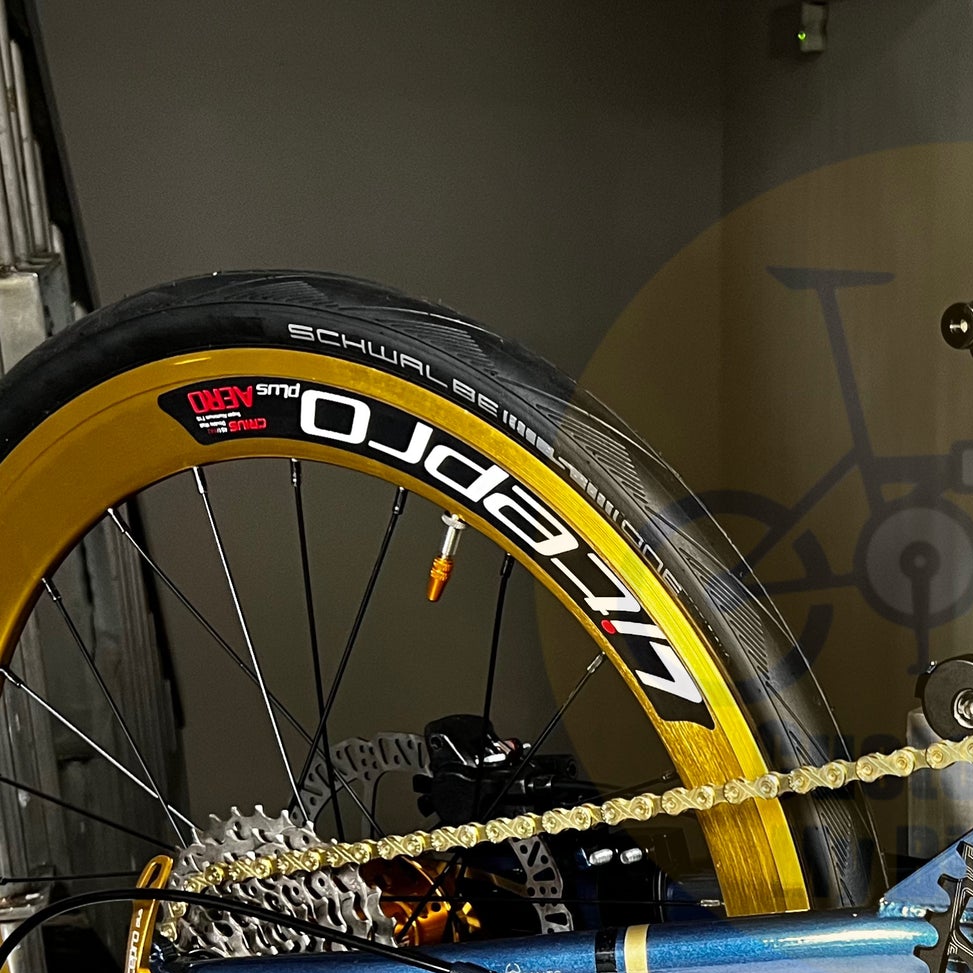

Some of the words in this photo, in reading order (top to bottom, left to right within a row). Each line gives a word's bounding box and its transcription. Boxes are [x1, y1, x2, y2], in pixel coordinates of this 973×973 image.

[288, 323, 499, 416] SCHWALBE
[187, 385, 253, 414] AERO
[255, 383, 301, 399] plus
[228, 418, 267, 432] CRIUS
